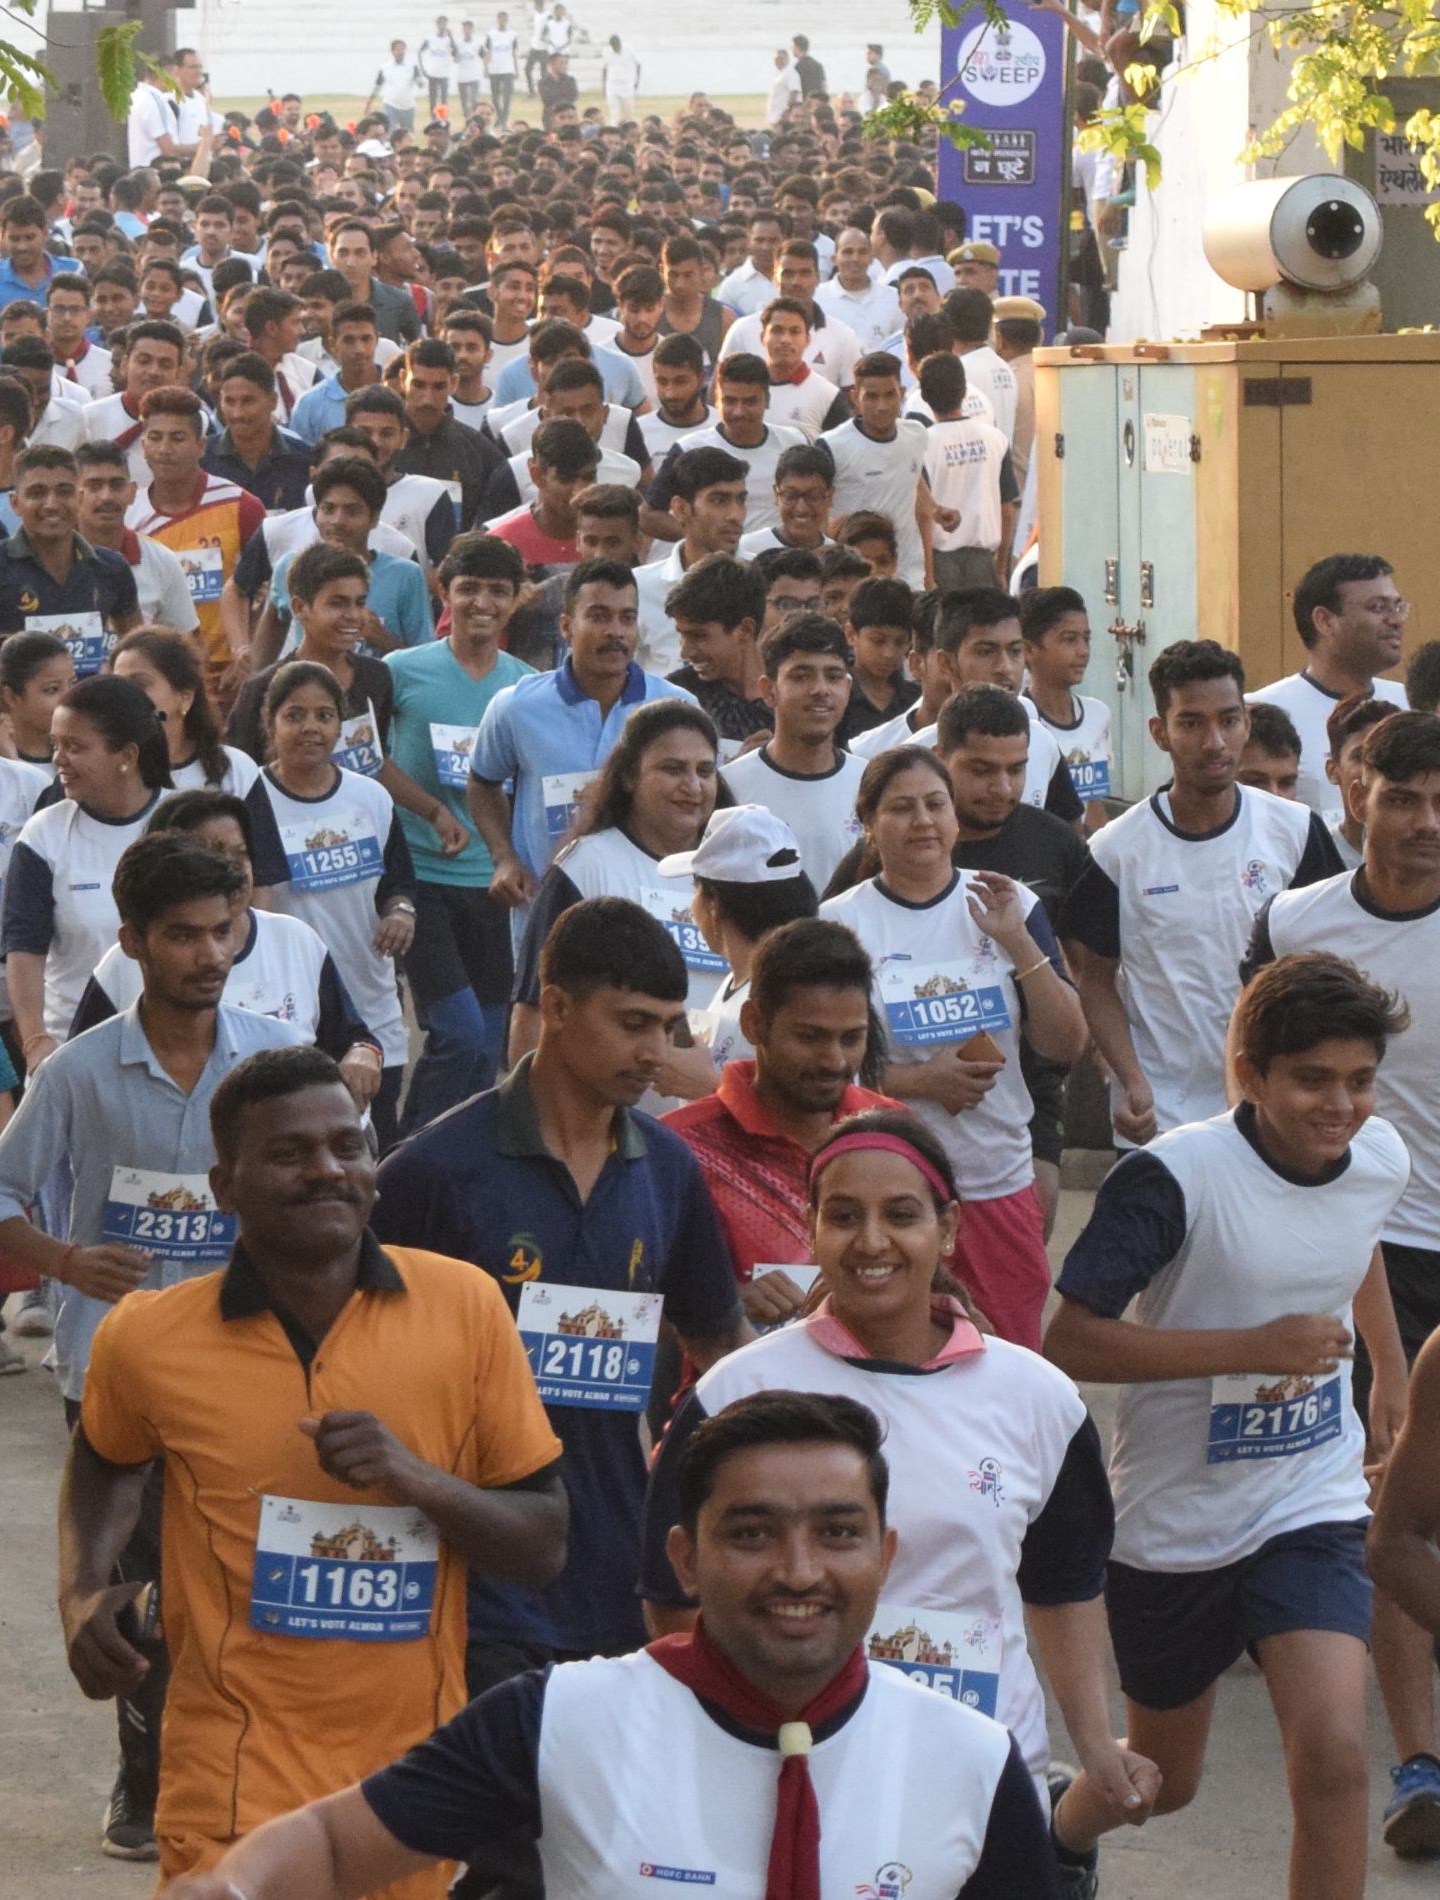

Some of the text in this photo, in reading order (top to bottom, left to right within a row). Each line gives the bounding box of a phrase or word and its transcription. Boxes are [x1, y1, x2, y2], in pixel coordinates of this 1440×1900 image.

[965, 67, 1039, 84] SWEEP
[964, 214, 1045, 248] ET'S
[998, 269, 1041, 301] TE
[187, 573, 206, 591] 81
[1069, 767, 1094, 786] 710
[306, 845, 359, 874] 1255
[914, 993, 979, 1026] 1052
[134, 1211, 209, 1242] 2313
[544, 1340, 623, 1380] 2118
[1244, 1395, 1318, 1436] 2176
[299, 1565, 399, 1608] 1163
[288, 1616, 318, 1629] LET'S
[320, 1618, 346, 1630] VOTE
[656, 1867, 682, 1878] HDFC
